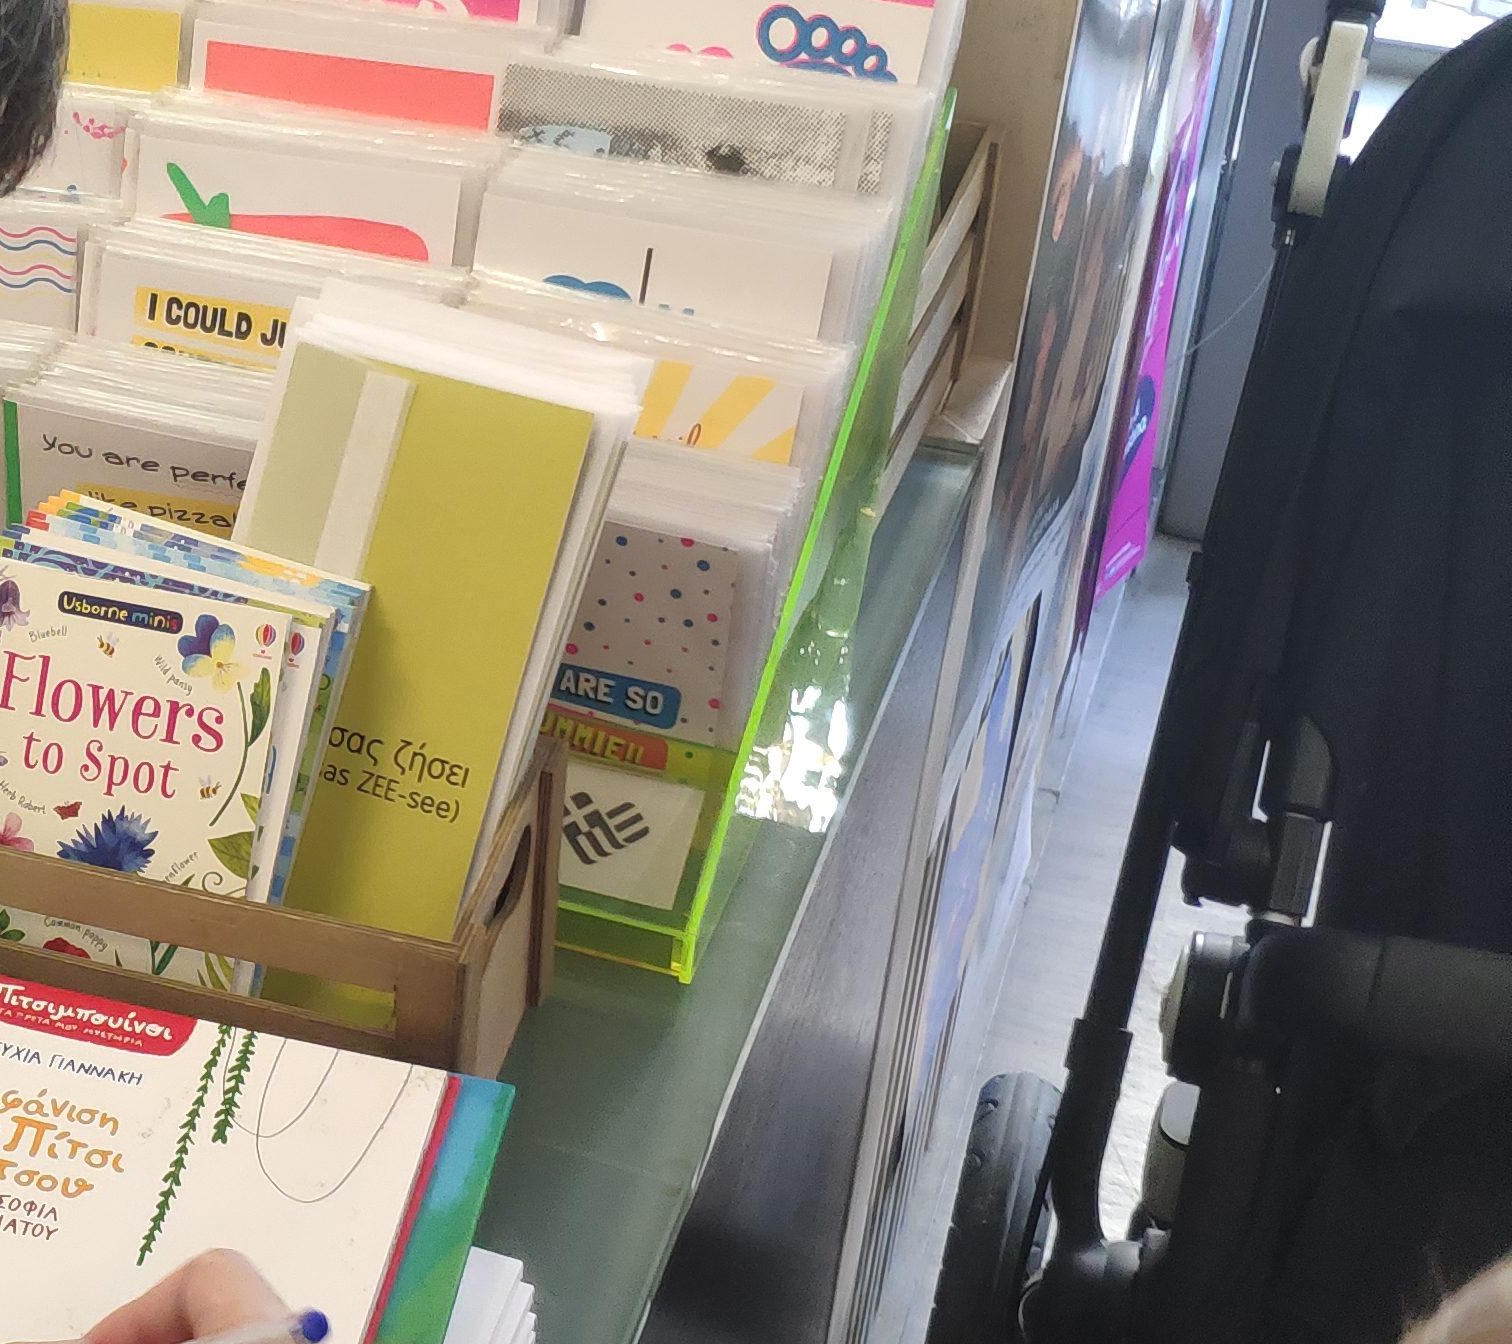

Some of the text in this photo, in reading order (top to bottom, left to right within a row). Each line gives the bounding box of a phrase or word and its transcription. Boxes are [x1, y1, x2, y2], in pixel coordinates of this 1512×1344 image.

[147, 292, 158, 321] I
[165, 296, 253, 341] COULD
[42, 433, 93, 459] you
[102, 451, 160, 472] are
[28, 625, 68, 642] Bluebell
[62, 594, 178, 631] Usborne minis
[154, 655, 194, 697] Wild pansy
[558, 668, 665, 716] ARE SO
[22, 731, 180, 800] to Spot
[328, 726, 470, 789] σας ζήσει
[19, 796, 47, 815] Robert
[319, 763, 461, 824] as ZEE-see)
[81, 928, 109, 953] poppy
[48, 1053, 144, 1086] ΓΙΑΝΝΑΚΗ
[2, 1115, 125, 1173] Πίτσι
